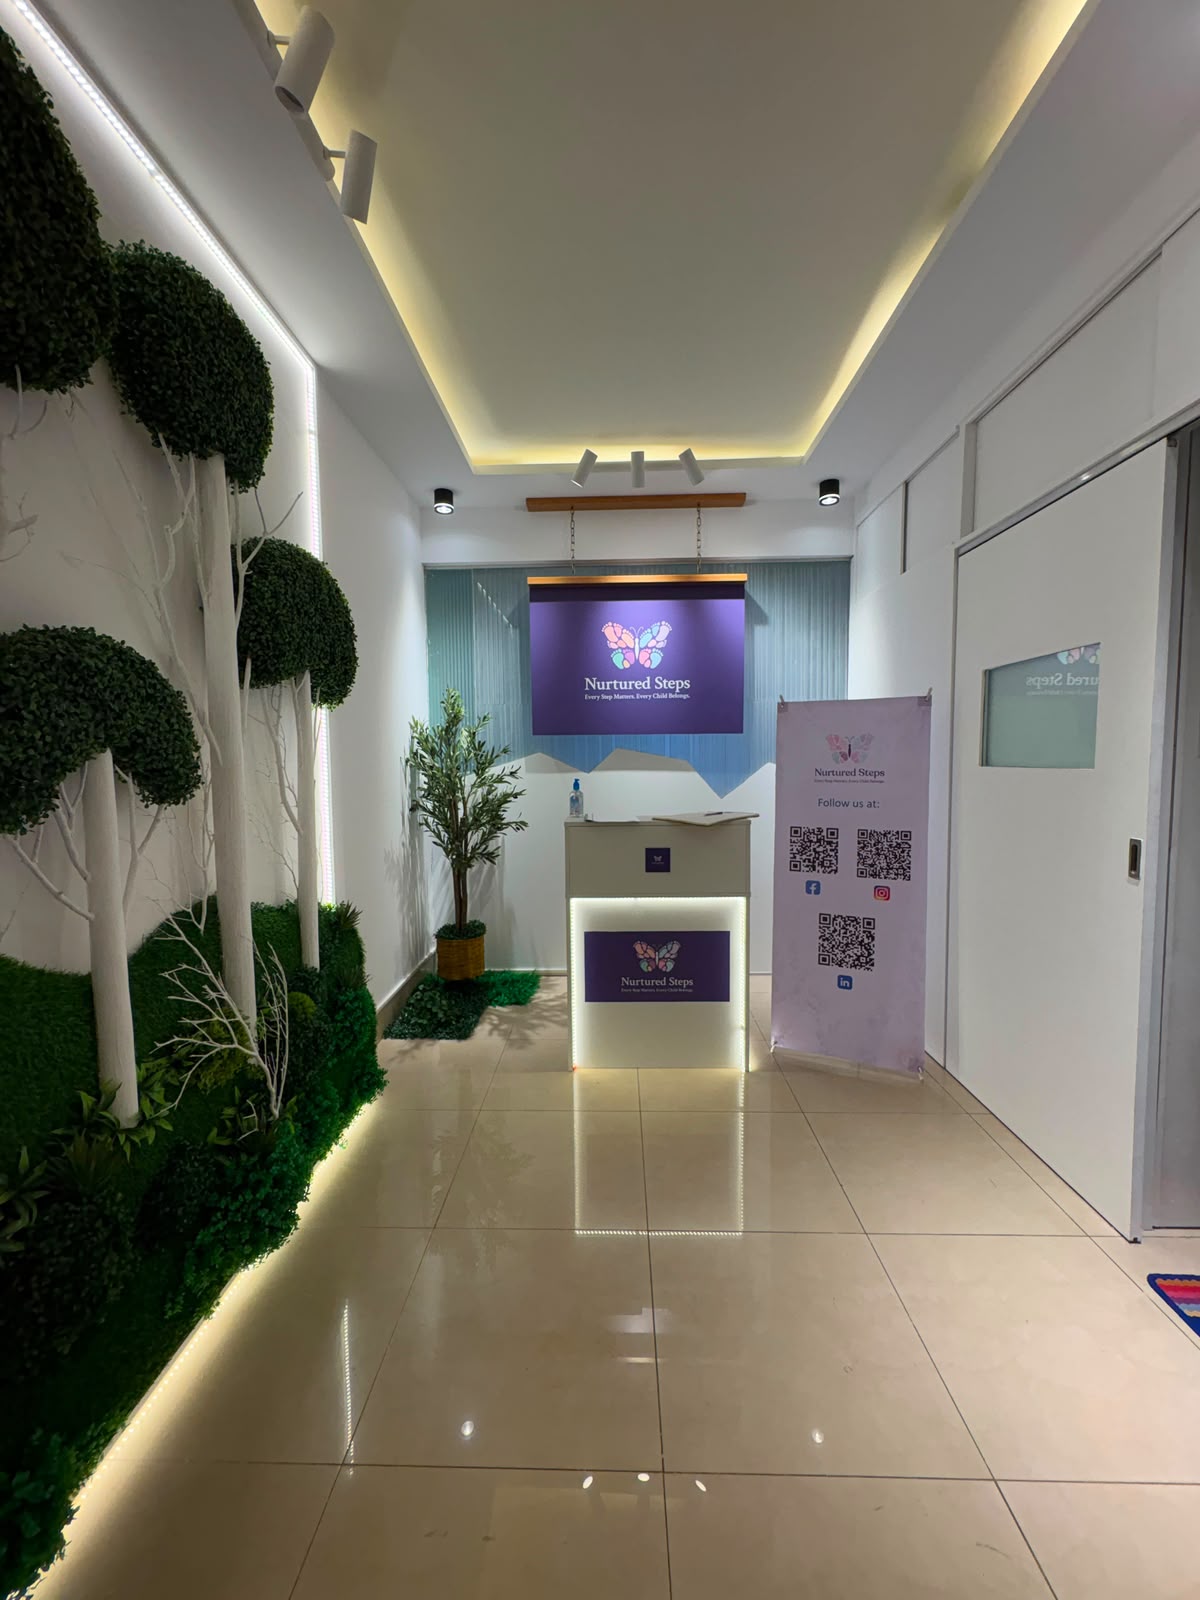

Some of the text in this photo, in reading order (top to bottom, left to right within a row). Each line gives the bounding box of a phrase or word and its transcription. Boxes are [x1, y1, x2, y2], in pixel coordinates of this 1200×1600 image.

[584, 676, 691, 692] Nurtured Steps
[814, 767, 885, 779] Nurtured Steps
[817, 797, 880, 808] Follow us at:
[621, 976, 694, 989] Nurtured Steps
